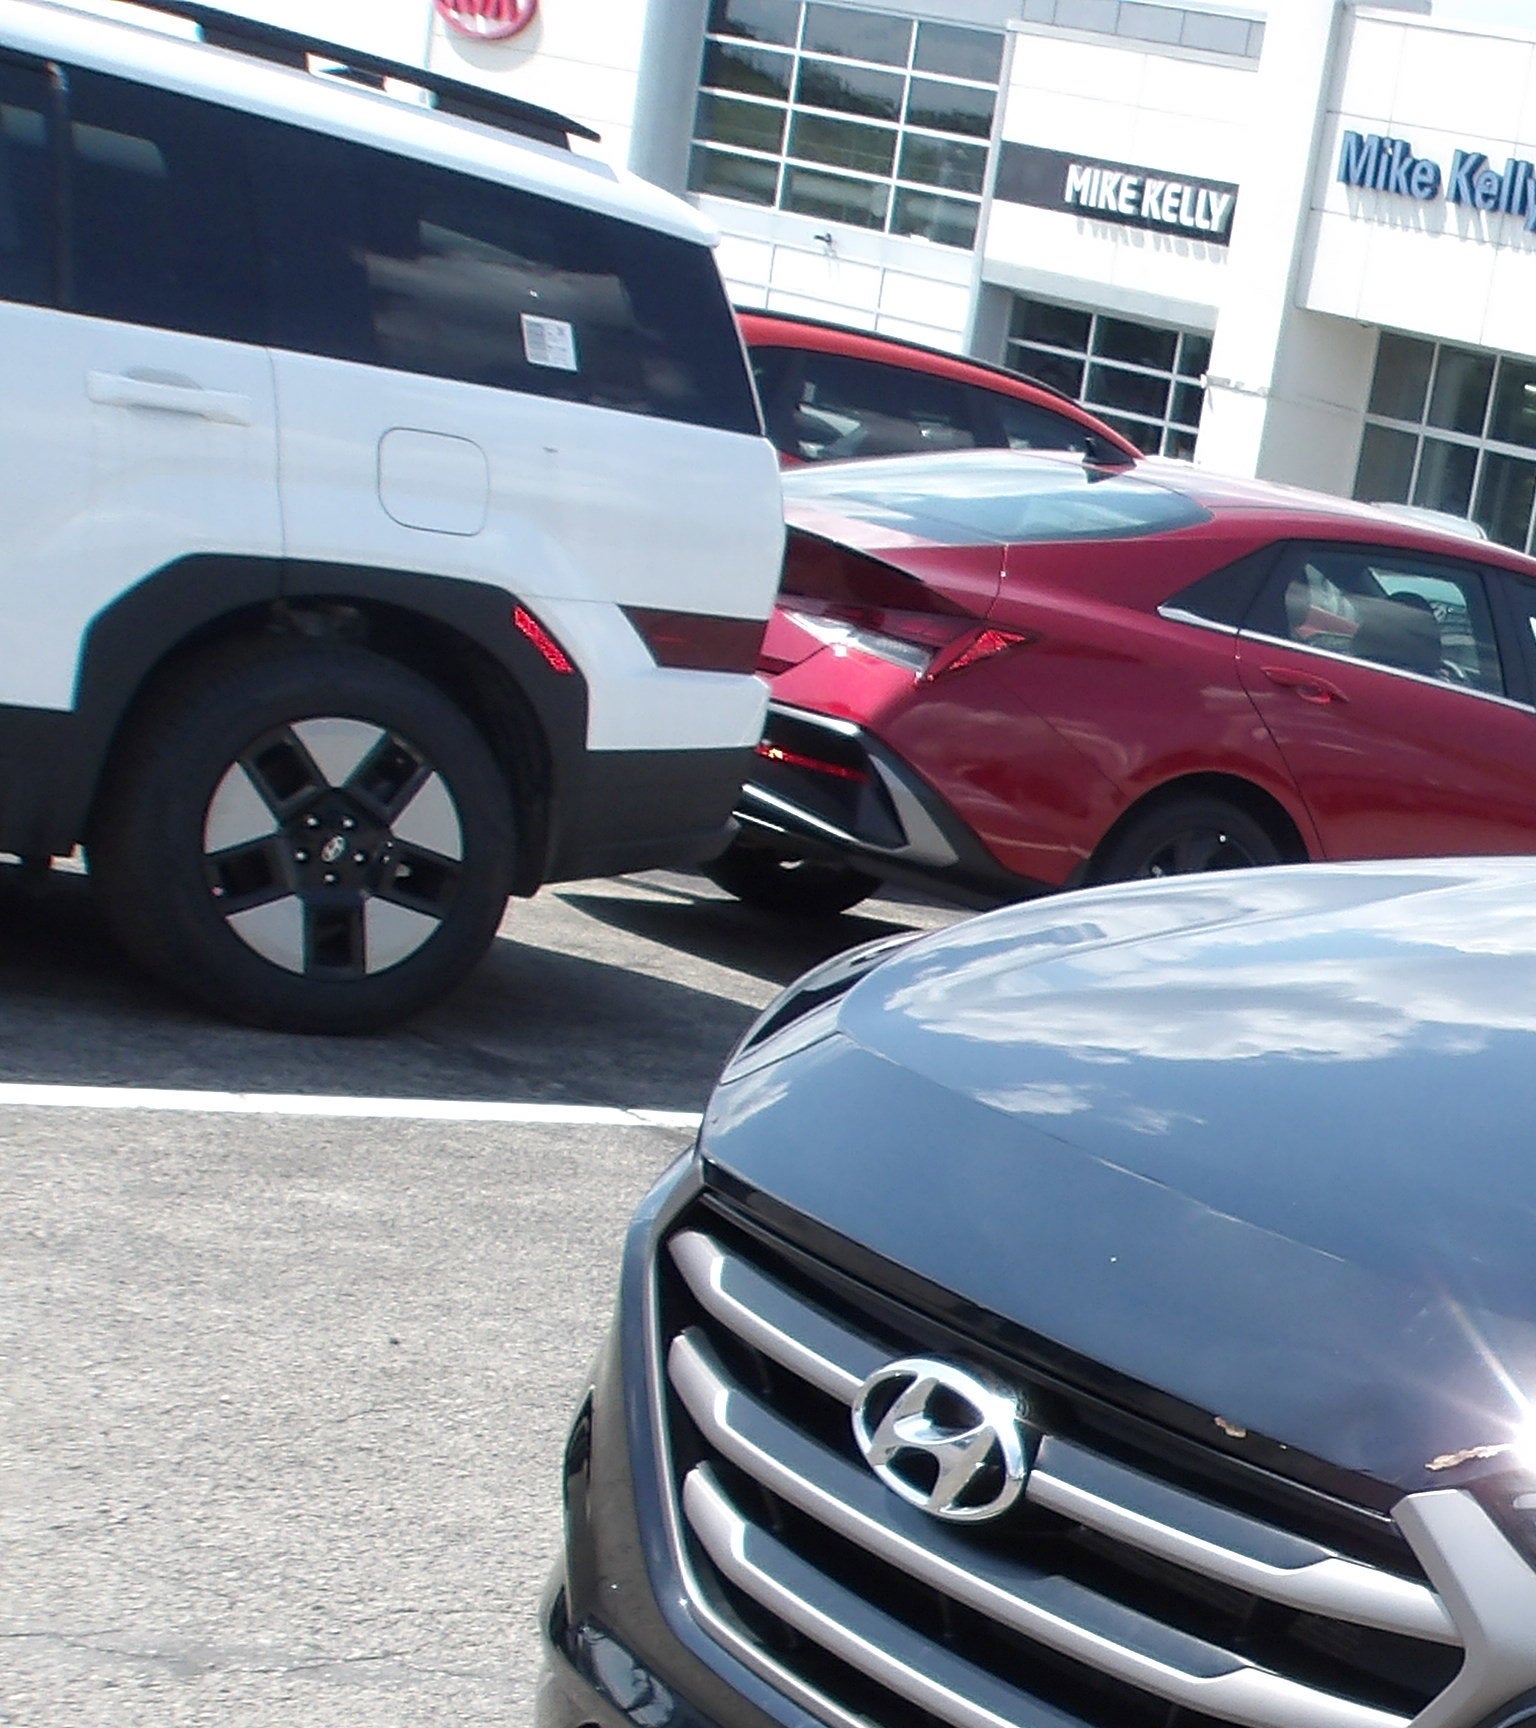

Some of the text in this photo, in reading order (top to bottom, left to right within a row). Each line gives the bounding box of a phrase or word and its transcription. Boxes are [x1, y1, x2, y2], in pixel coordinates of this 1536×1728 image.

[1064, 163, 1234, 233] MIKE KELLY
[1337, 130, 1442, 200] Mike
